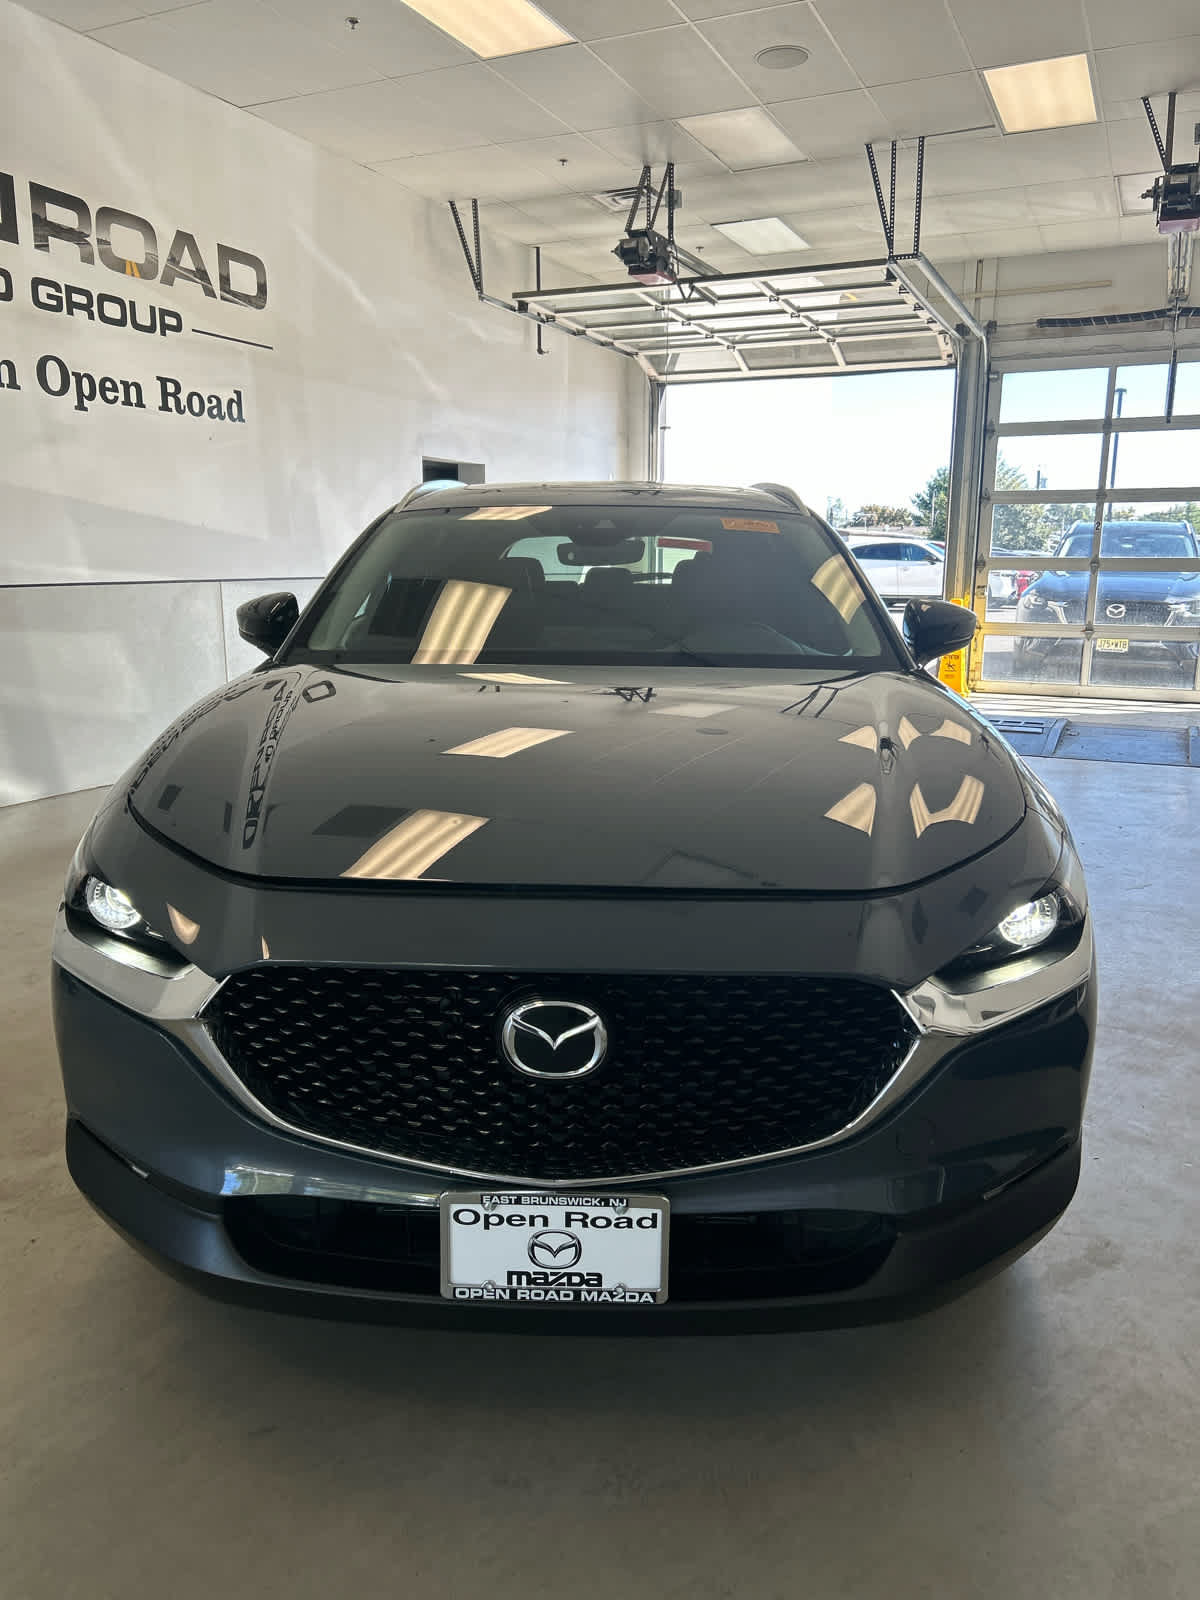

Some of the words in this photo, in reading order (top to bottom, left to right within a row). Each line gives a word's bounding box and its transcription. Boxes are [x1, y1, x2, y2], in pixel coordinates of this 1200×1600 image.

[31, 276, 183, 337] GROUP
[35, 354, 146, 412] Open
[155, 375, 246, 424] Road
[482, 1195, 518, 1206] EAST
[608, 1199, 627, 1208] NJ
[452, 1208, 549, 1231] Open
[564, 1211, 659, 1230] Road
[506, 1270, 603, 1288] mazda
[455, 1287, 510, 1301] OPEN
[516, 1289, 577, 1302] ROAD
[581, 1290, 654, 1304] MAZDA
